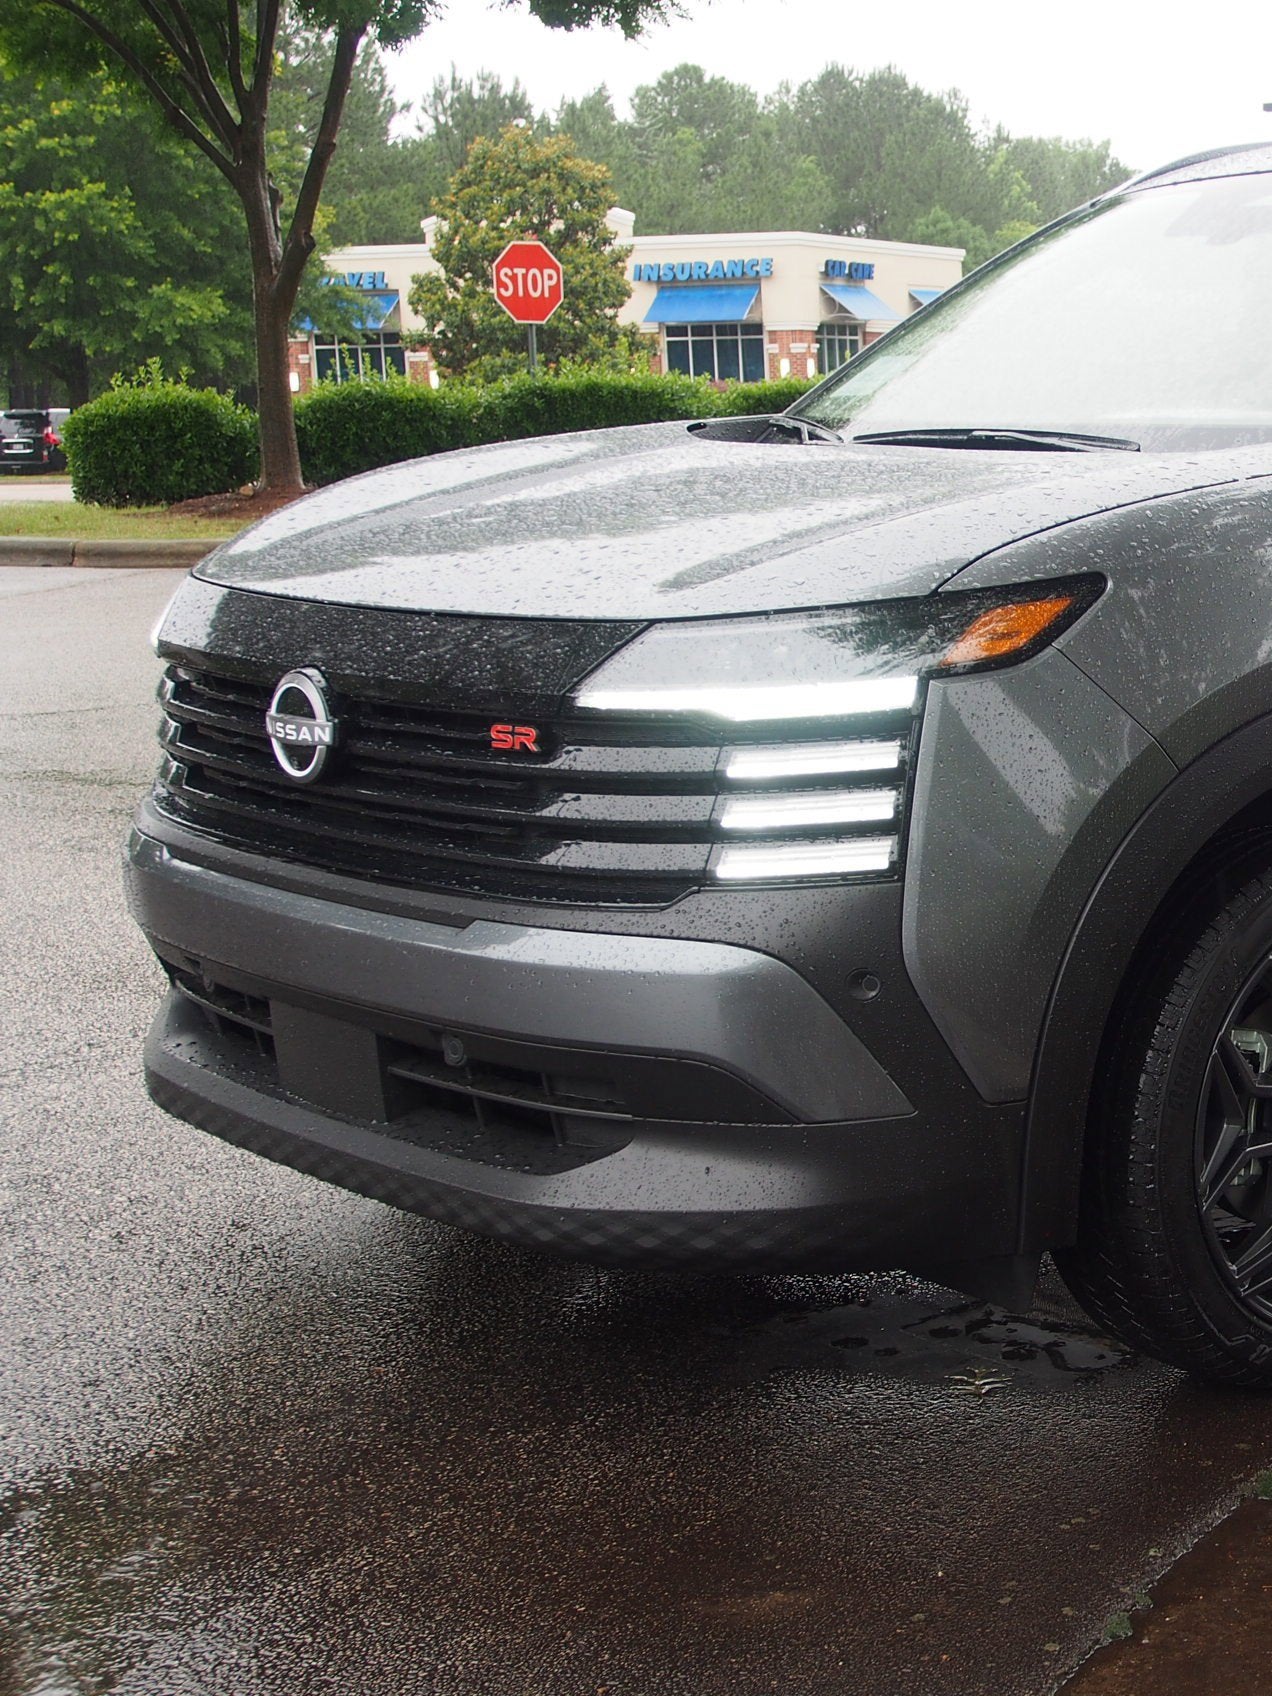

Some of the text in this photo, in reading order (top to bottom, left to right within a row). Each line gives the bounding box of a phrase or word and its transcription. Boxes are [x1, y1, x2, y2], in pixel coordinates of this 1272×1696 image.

[318, 271, 388, 289] AVEL
[633, 258, 773, 281] INSURANCE
[499, 267, 558, 298] STOP
[490, 724, 537, 752] SR
